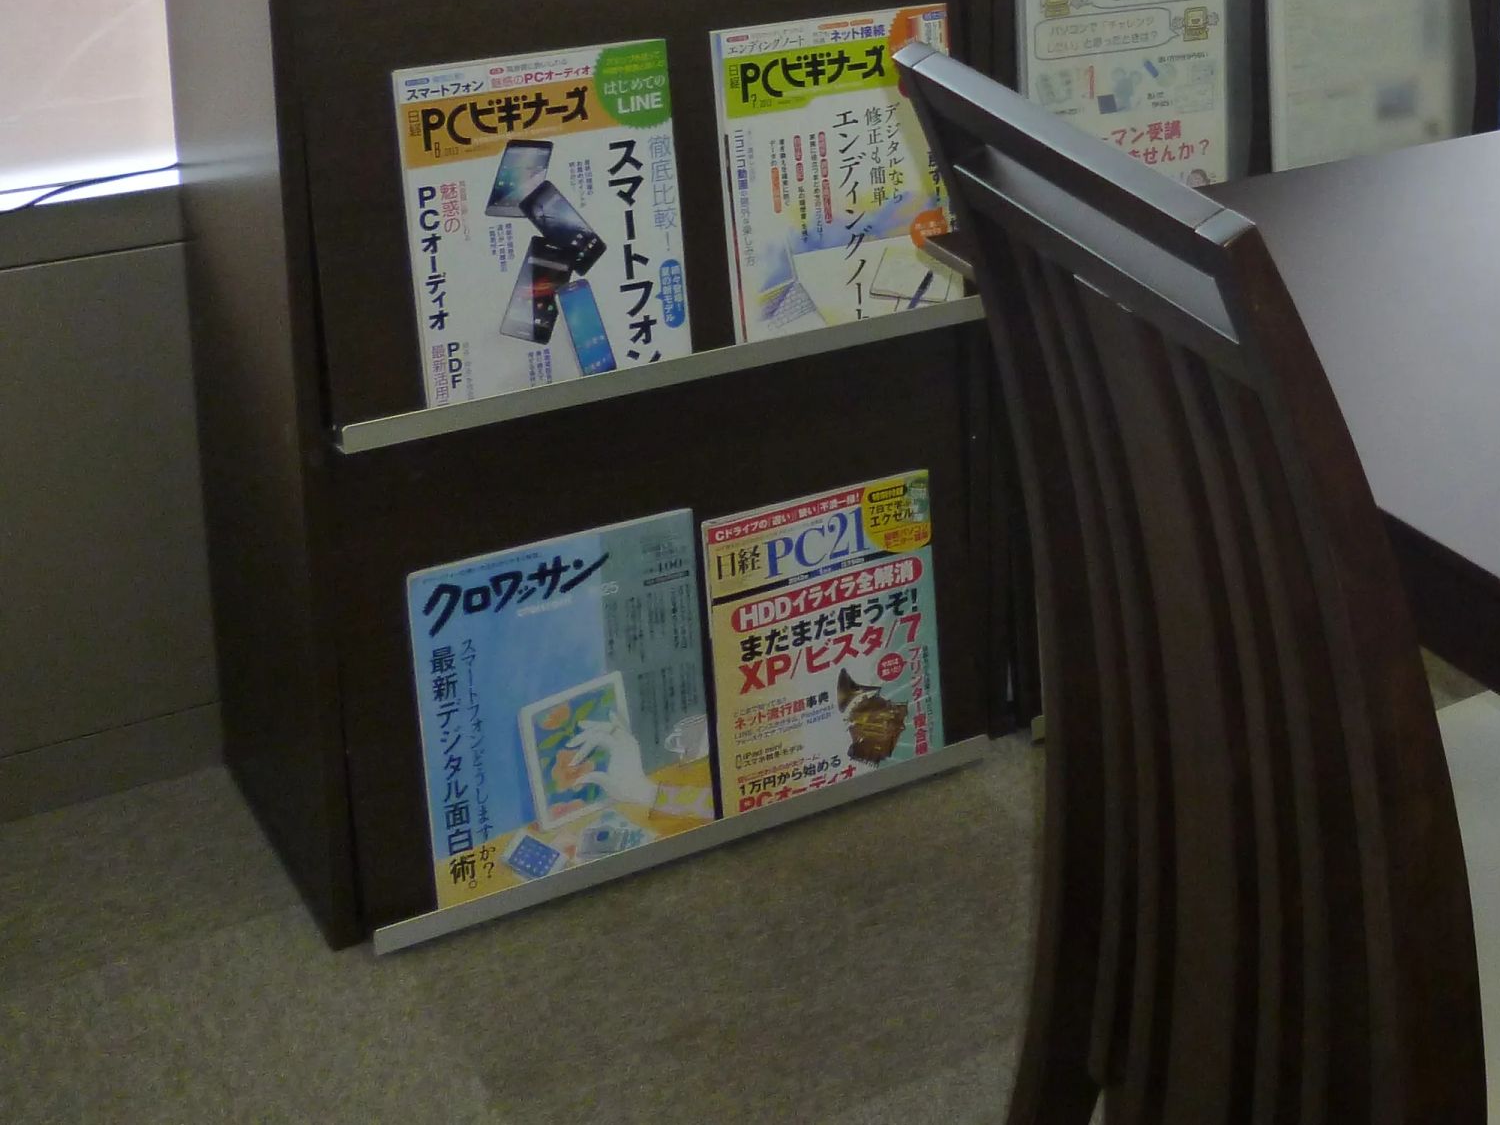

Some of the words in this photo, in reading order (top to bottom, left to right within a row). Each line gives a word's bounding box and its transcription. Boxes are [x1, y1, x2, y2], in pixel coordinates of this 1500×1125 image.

[407, 80, 484, 101] スマートフォン
[603, 74, 666, 96] はじめての
[617, 92, 664, 114] LINE
[739, 44, 887, 103] PCビギナーズ
[421, 86, 589, 152] PCビギナーズ
[885, 102, 905, 205] デジタルなら
[864, 106, 890, 207] 修正も簡単
[417, 185, 450, 332] PCオーディオ
[431, 344, 450, 406] 最新活用
[447, 342, 463, 389] PDF
[716, 544, 762, 580] 日経
[764, 506, 870, 580] PC21
[422, 551, 610, 638] クロワッサン
[738, 559, 916, 631] HDDイライラ全解消
[740, 587, 919, 663] まだまだ使うぞ!
[738, 612, 922, 696] XP/ビスタ/7
[429, 644, 479, 890] 最新デジタル面白術。
[739, 754, 843, 796] 1万円から始める
